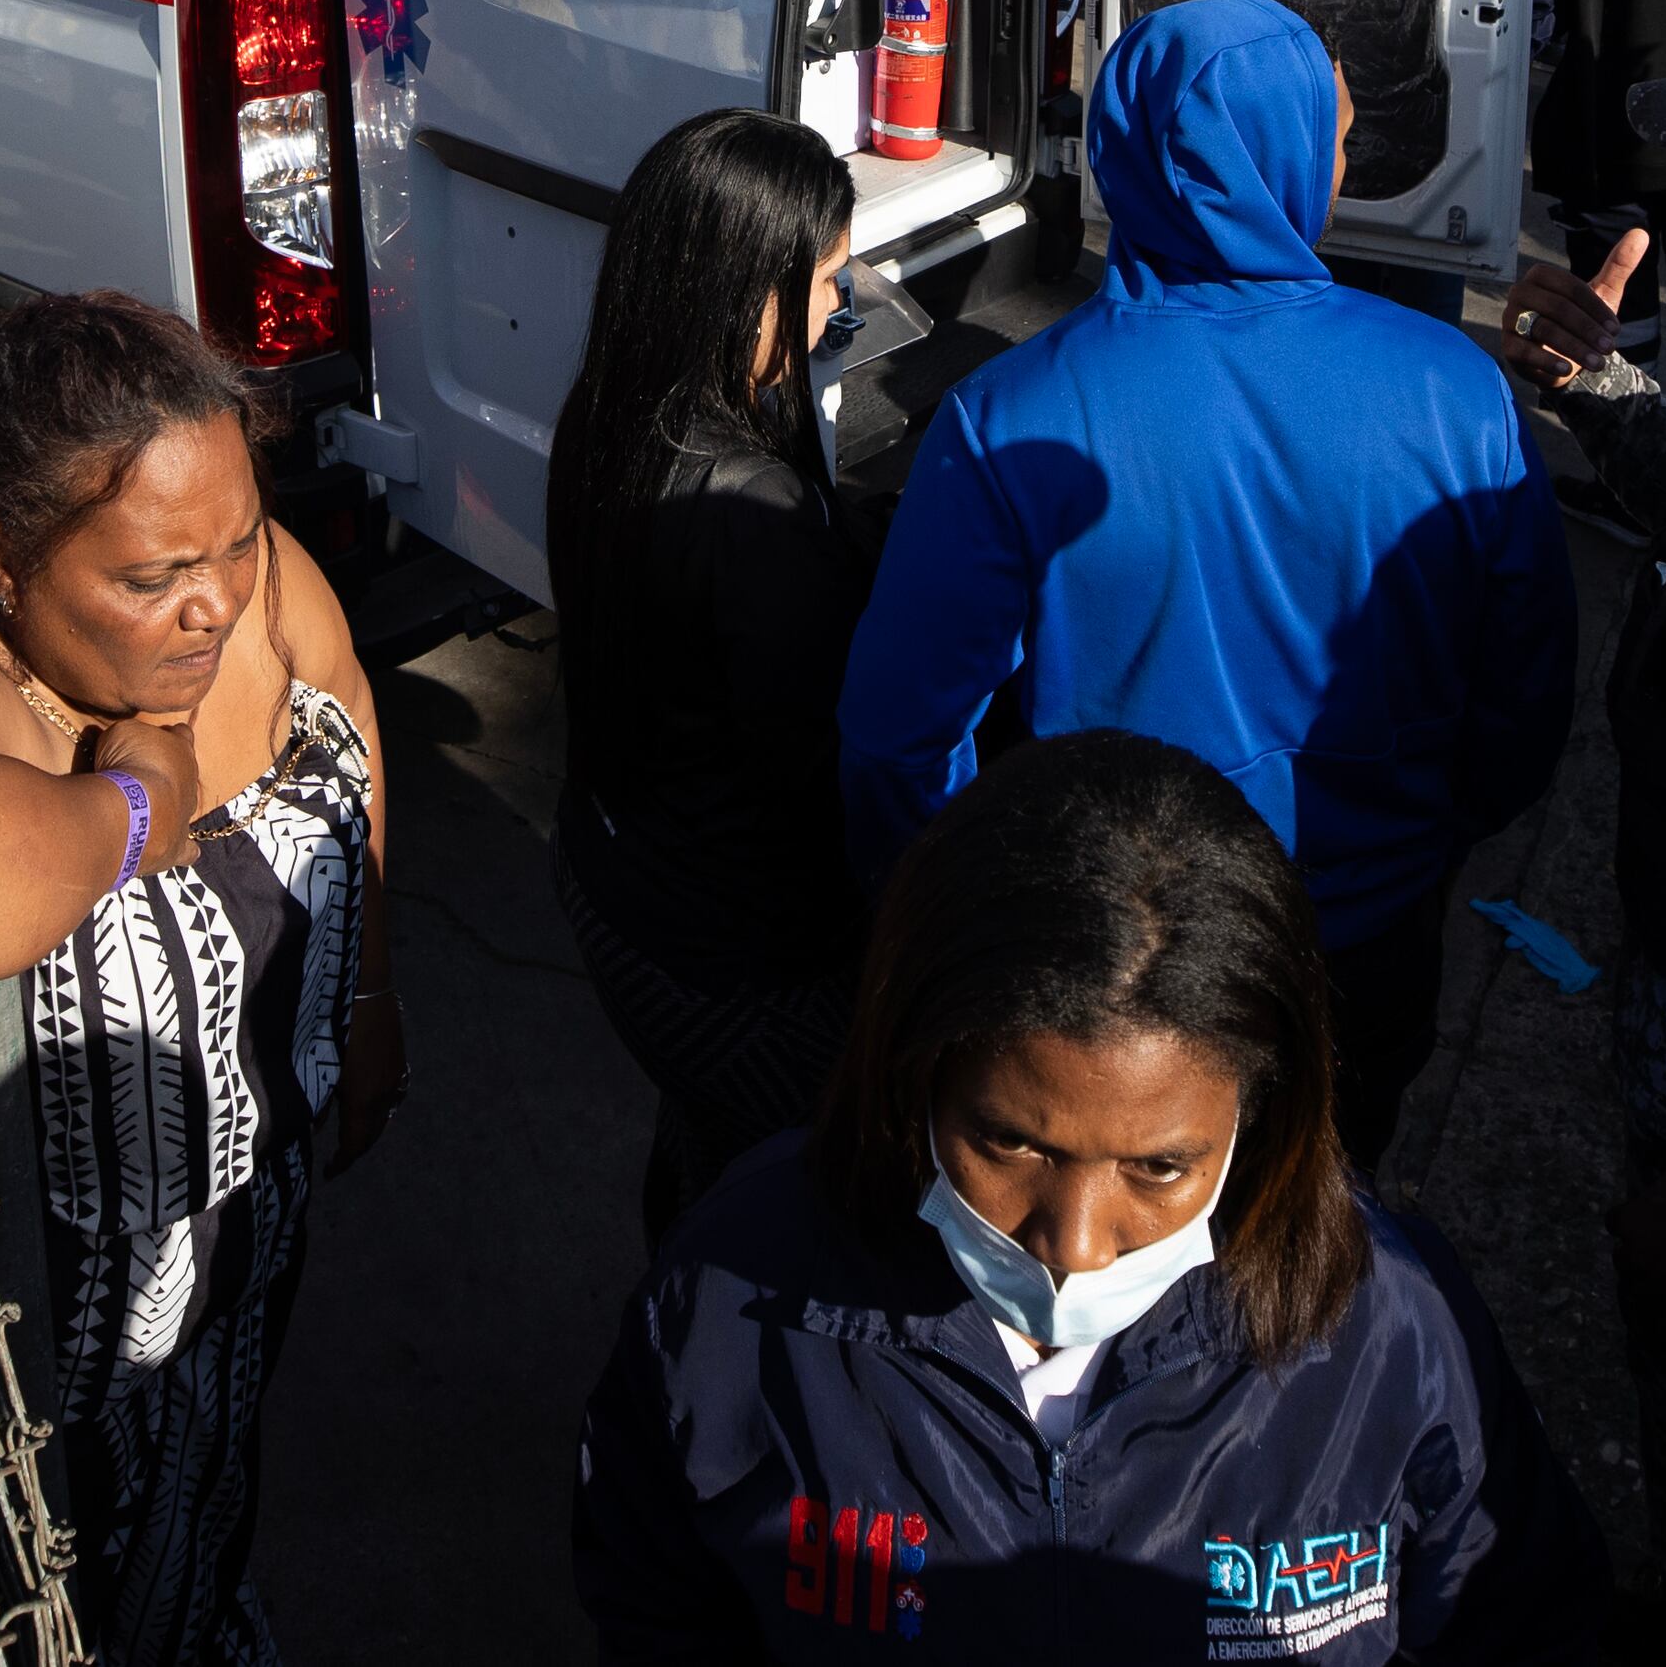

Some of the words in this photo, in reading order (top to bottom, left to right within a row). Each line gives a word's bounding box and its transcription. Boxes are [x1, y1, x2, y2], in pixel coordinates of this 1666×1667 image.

[785, 1496, 895, 1633] 911
[1203, 1522, 1389, 1613] DAEH
[1206, 1611, 1265, 1636] DIRECCIÓN
[1266, 1618, 1282, 1635] DE
[1284, 1605, 1332, 1634] SERVICIOS
[1331, 1600, 1345, 1617] DE
[1345, 1582, 1389, 1613] ATENCIÓN
[1207, 1643, 1218, 1662] A
[1219, 1636, 1295, 1662] EMERGENCIAS
